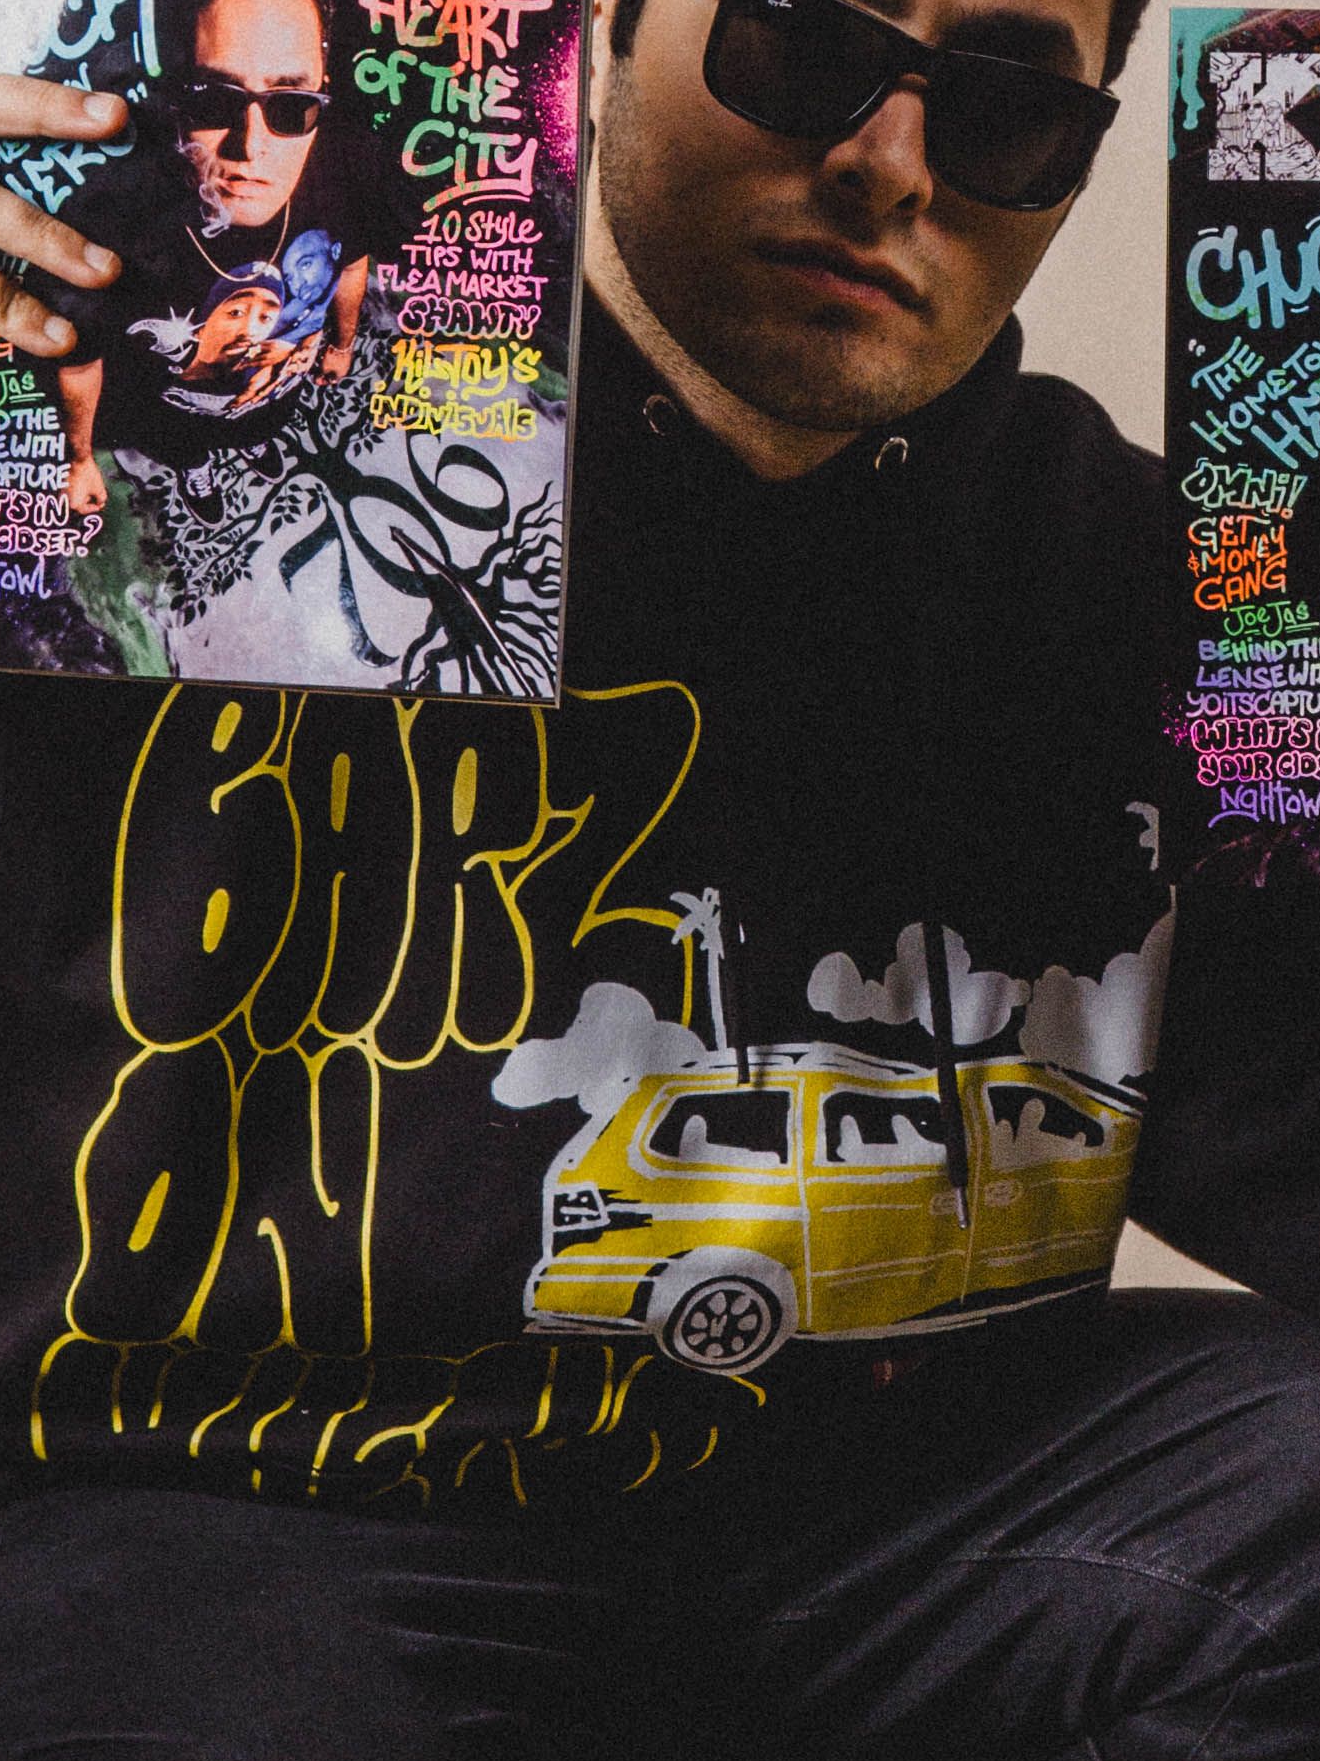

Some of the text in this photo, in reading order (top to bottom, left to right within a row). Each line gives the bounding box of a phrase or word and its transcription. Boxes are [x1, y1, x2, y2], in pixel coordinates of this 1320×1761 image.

[419, 60, 522, 122] THE
[414, 209, 543, 249] 10 Style
[401, 244, 533, 275] TIPS WITH
[376, 263, 549, 301] FLEA MARKET
[397, 294, 542, 340] SHAWTY
[9, 406, 60, 431] THE
[10, 432, 66, 462] WITH
[1187, 514, 1271, 554] GET
[1193, 558, 1288, 614] GANG
[1195, 663, 1288, 690] LENSE
[1190, 716, 1314, 753] WHAT'S
[1196, 751, 1273, 787] YOUR
